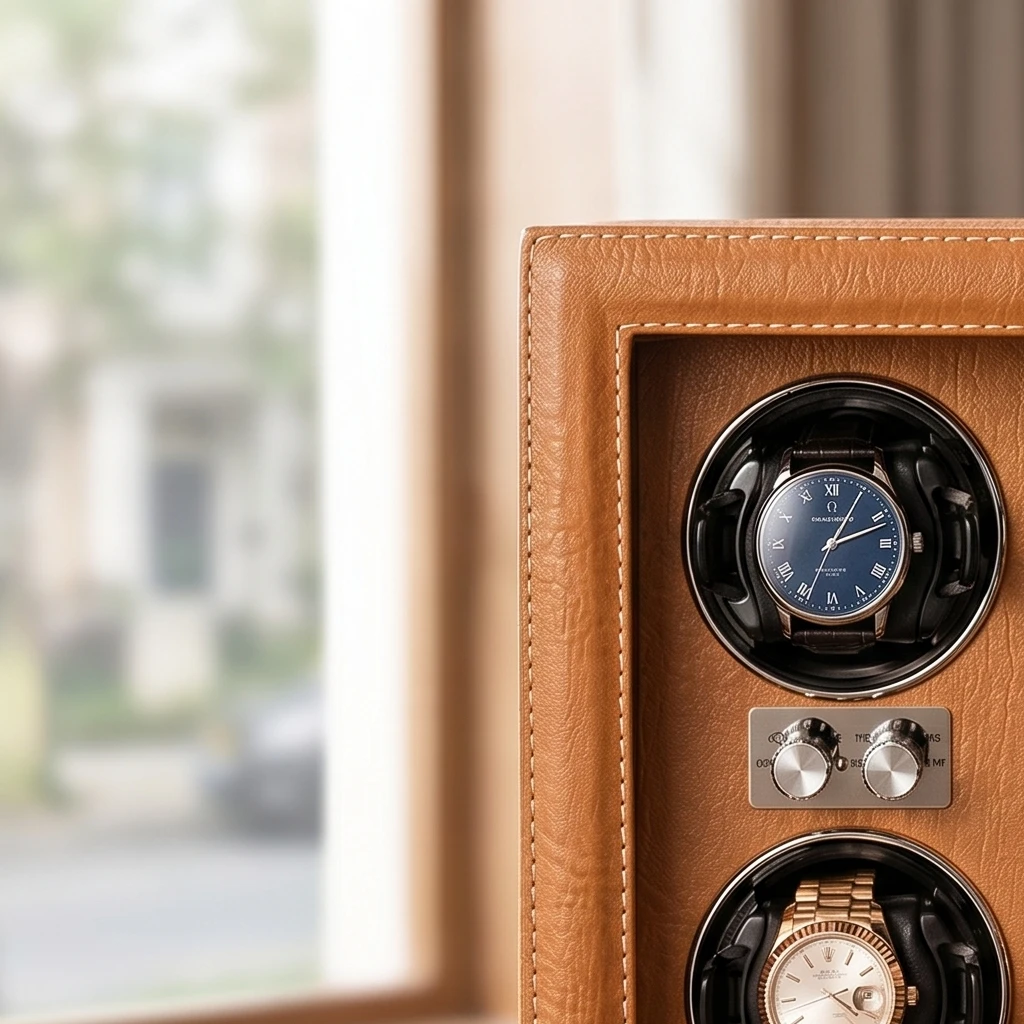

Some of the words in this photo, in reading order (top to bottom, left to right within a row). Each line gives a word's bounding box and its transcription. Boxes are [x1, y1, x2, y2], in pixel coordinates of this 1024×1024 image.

[825, 484, 839, 496] XII
[871, 511, 885, 523] II
[879, 538, 892, 549] III
[855, 585, 866, 598] V
[827, 591, 839, 605] VI
